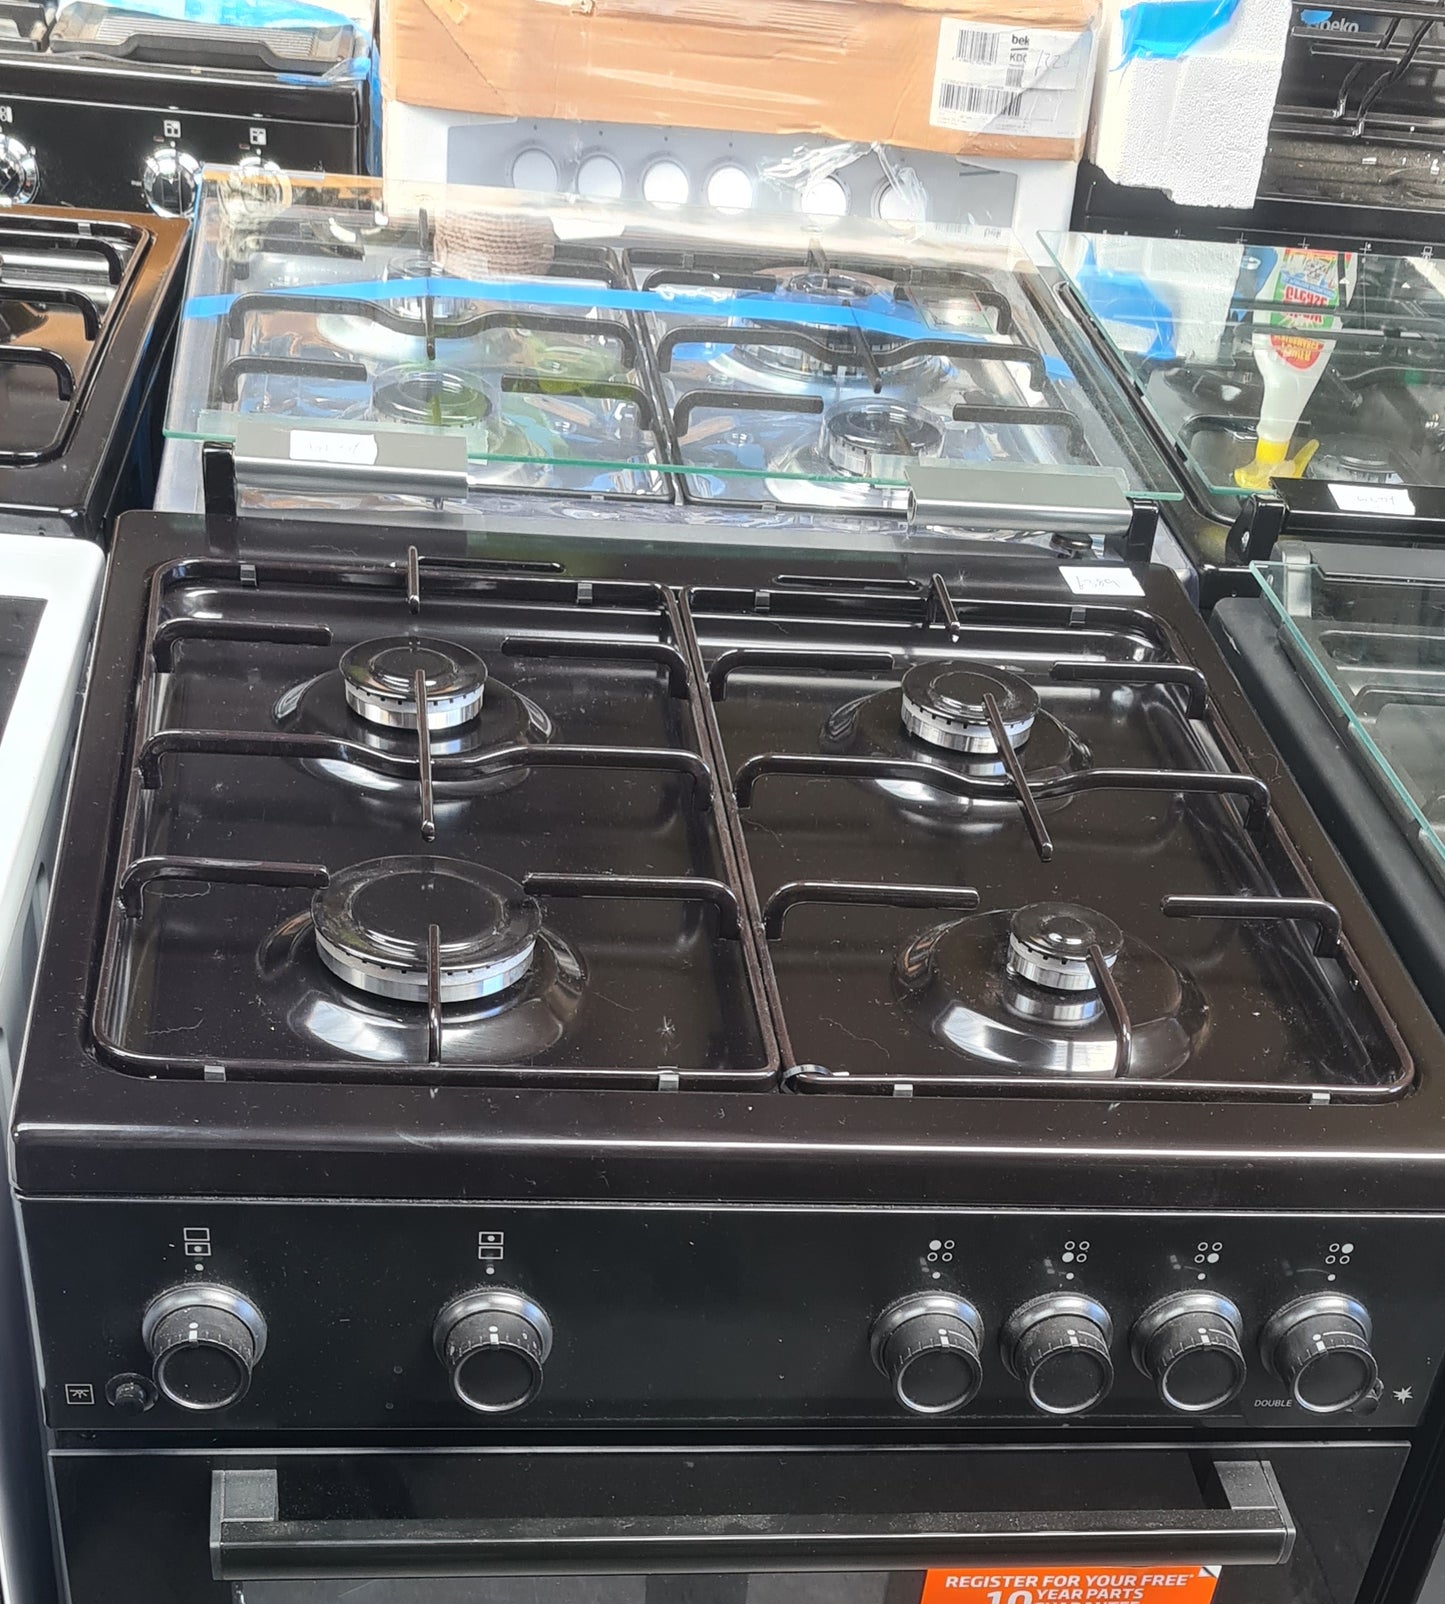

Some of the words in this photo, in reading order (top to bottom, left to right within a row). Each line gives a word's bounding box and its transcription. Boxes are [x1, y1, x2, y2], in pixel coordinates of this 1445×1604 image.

[1011, 34, 1030, 46] bek
[1254, 1399, 1293, 1408] DOUBLE
[945, 1575, 1039, 1588] REGISTER
[1042, 1575, 1081, 1587] FOR
[1085, 1574, 1137, 1587] YOUR
[1037, 1588, 1083, 1600] YEAR
[1086, 1588, 1145, 1599] PARTS
